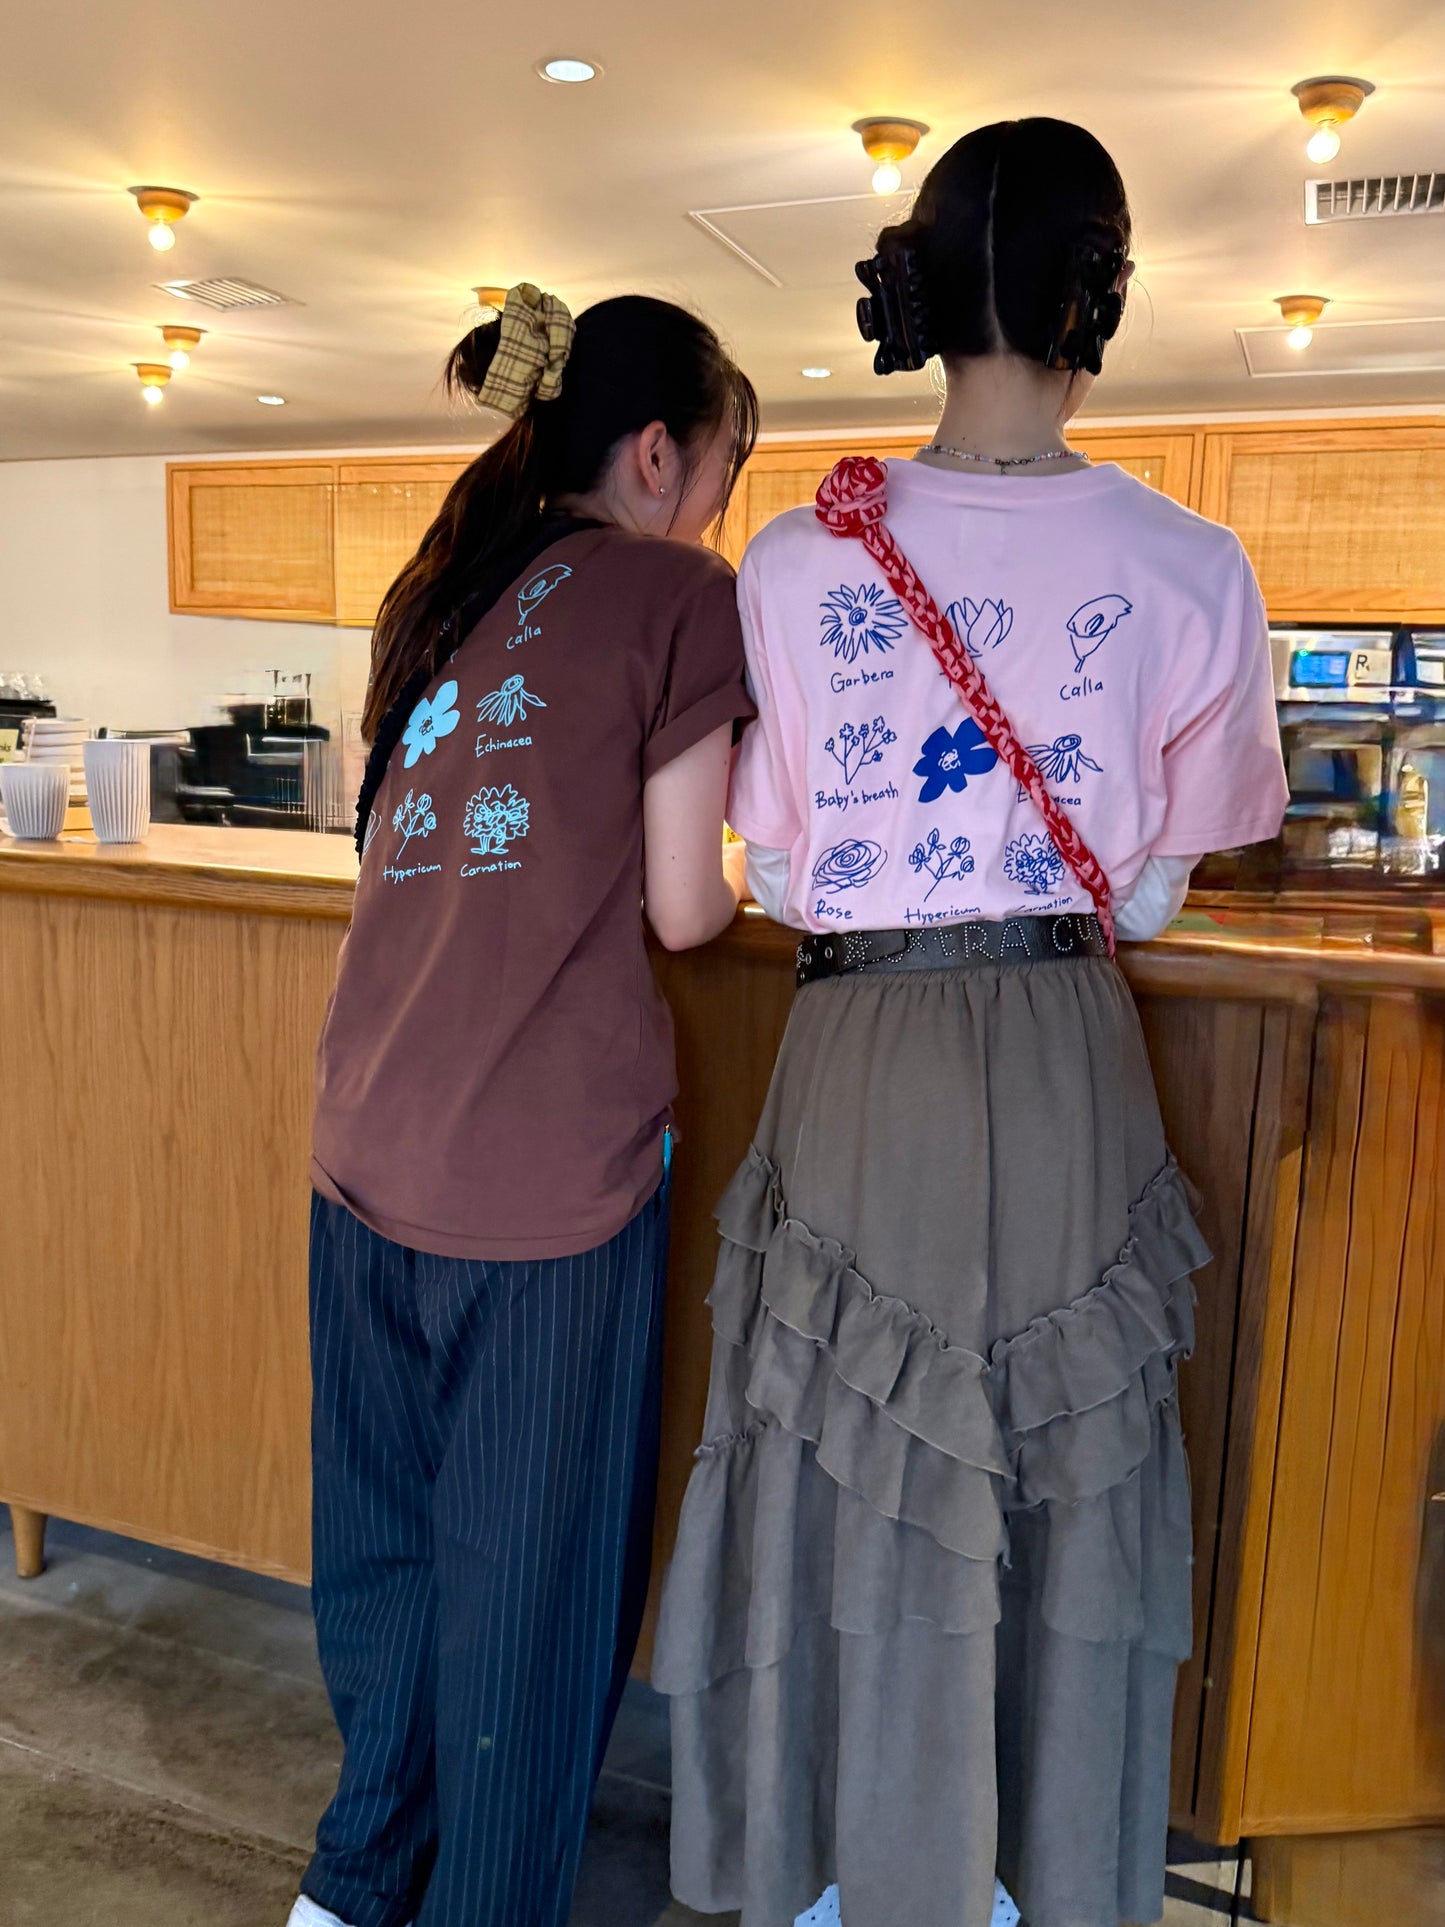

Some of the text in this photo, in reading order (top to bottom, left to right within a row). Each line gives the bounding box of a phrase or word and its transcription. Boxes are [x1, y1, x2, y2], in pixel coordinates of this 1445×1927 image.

[474, 733, 533, 758] Echinacea
[814, 780, 899, 813] Baby's breath
[382, 862, 442, 885] Hypericum
[459, 860, 522, 878] Carnation
[813, 898, 854, 920] Rose
[903, 904, 982, 926] Hypericum
